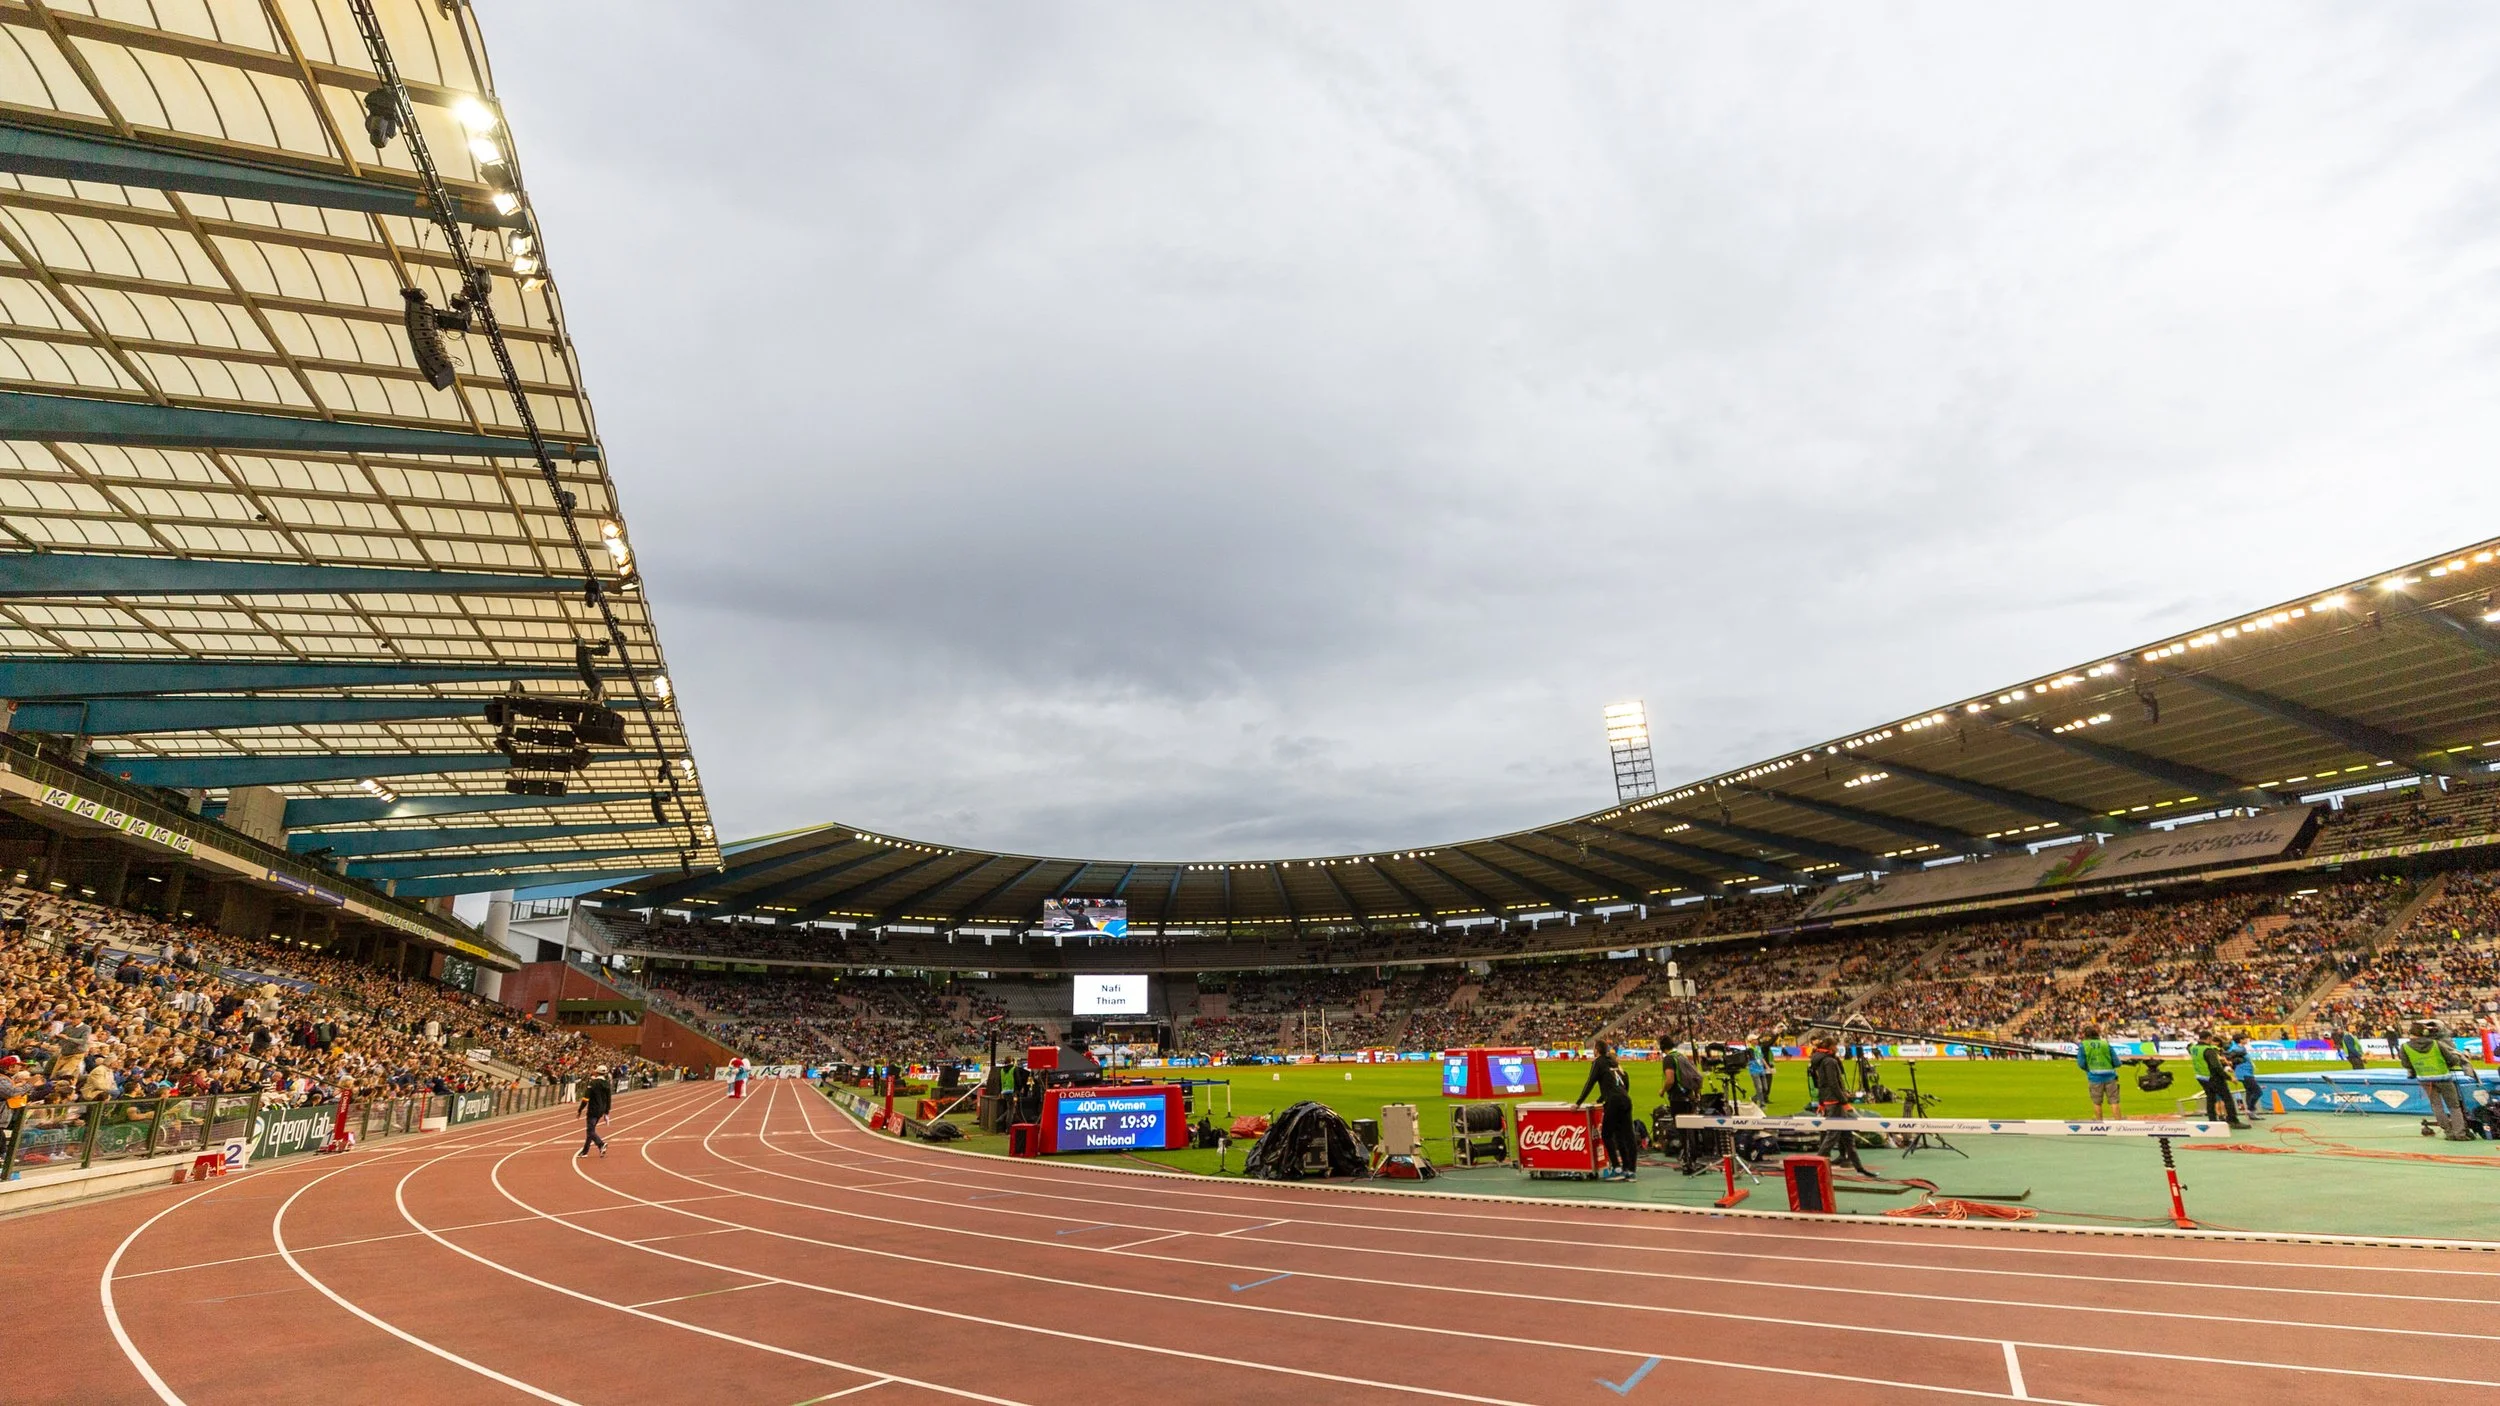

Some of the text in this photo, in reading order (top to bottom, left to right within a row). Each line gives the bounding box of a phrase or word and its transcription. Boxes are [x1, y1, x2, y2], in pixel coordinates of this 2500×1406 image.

[46, 790, 189, 850] AG AG AG AG AG AG
[2117, 844, 2169, 861] AG
[2314, 836, 2484, 866] AG AG AG AG AG AG
[1101, 984, 1121, 992] Nafi
[1096, 996, 1126, 1005] Thiam
[761, 1067, 781, 1076] AG
[1068, 1091, 1096, 1099] OMEGA
[1077, 1100, 1147, 1112] 400m Women
[1065, 1114, 1157, 1131] START 19:39
[268, 1107, 331, 1157] energy lab
[1086, 1133, 1136, 1146] National
[1520, 1125, 1587, 1151] Coca-Cola
[226, 1144, 243, 1165] 2
